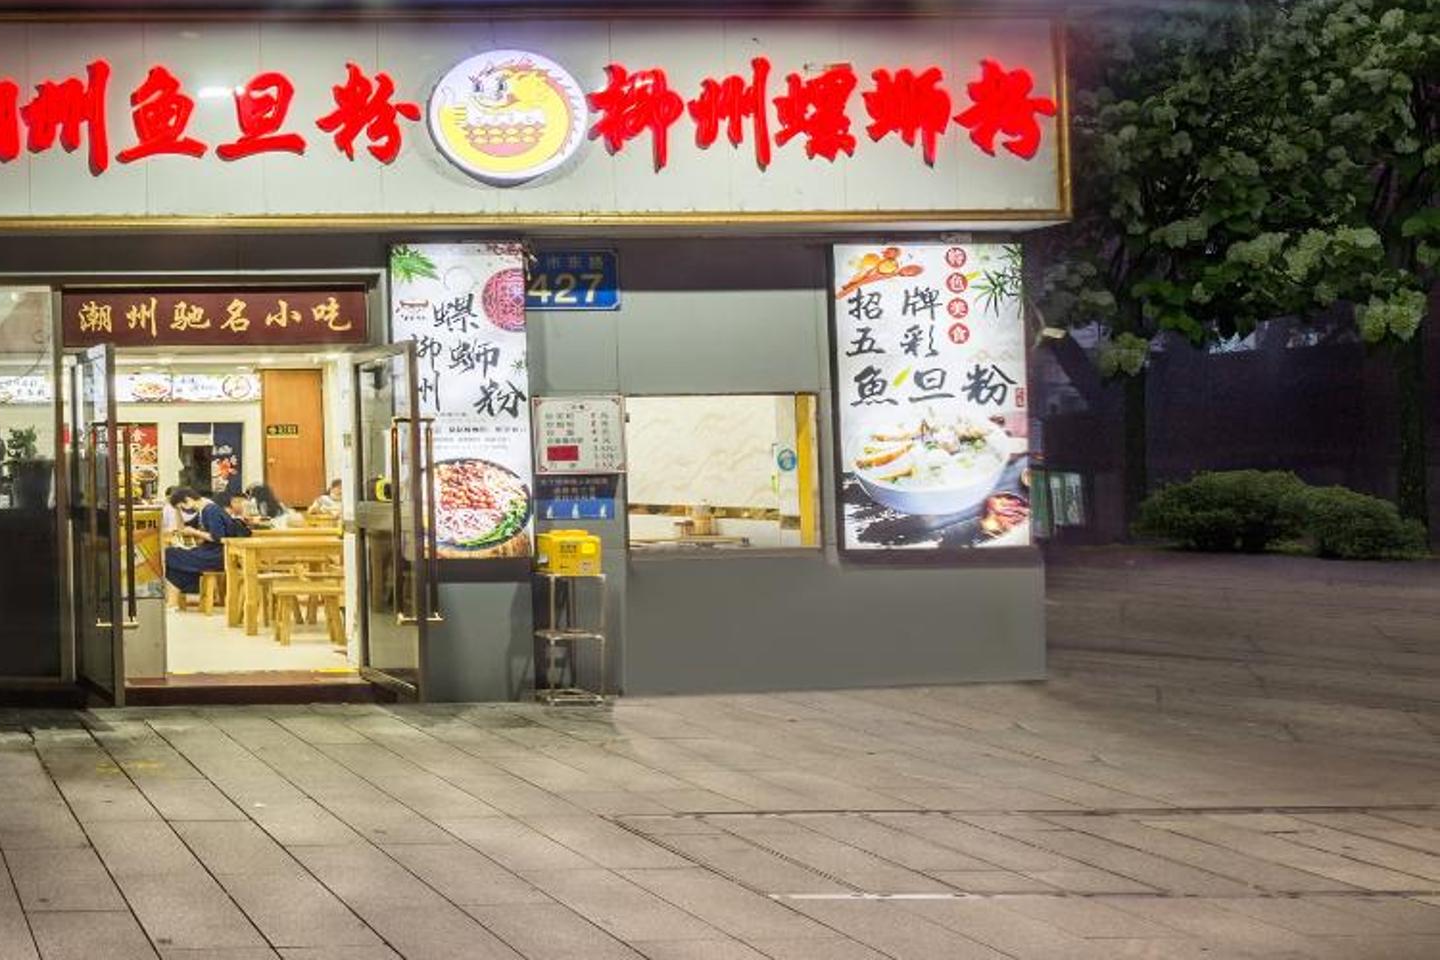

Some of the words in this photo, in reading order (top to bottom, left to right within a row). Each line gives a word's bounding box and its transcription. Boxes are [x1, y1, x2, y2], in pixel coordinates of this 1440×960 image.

[526, 273, 604, 304] 427
[848, 287, 943, 321] 招牌
[77, 296, 353, 338] 潮州驰名小吃
[846, 323, 939, 359] 五彩
